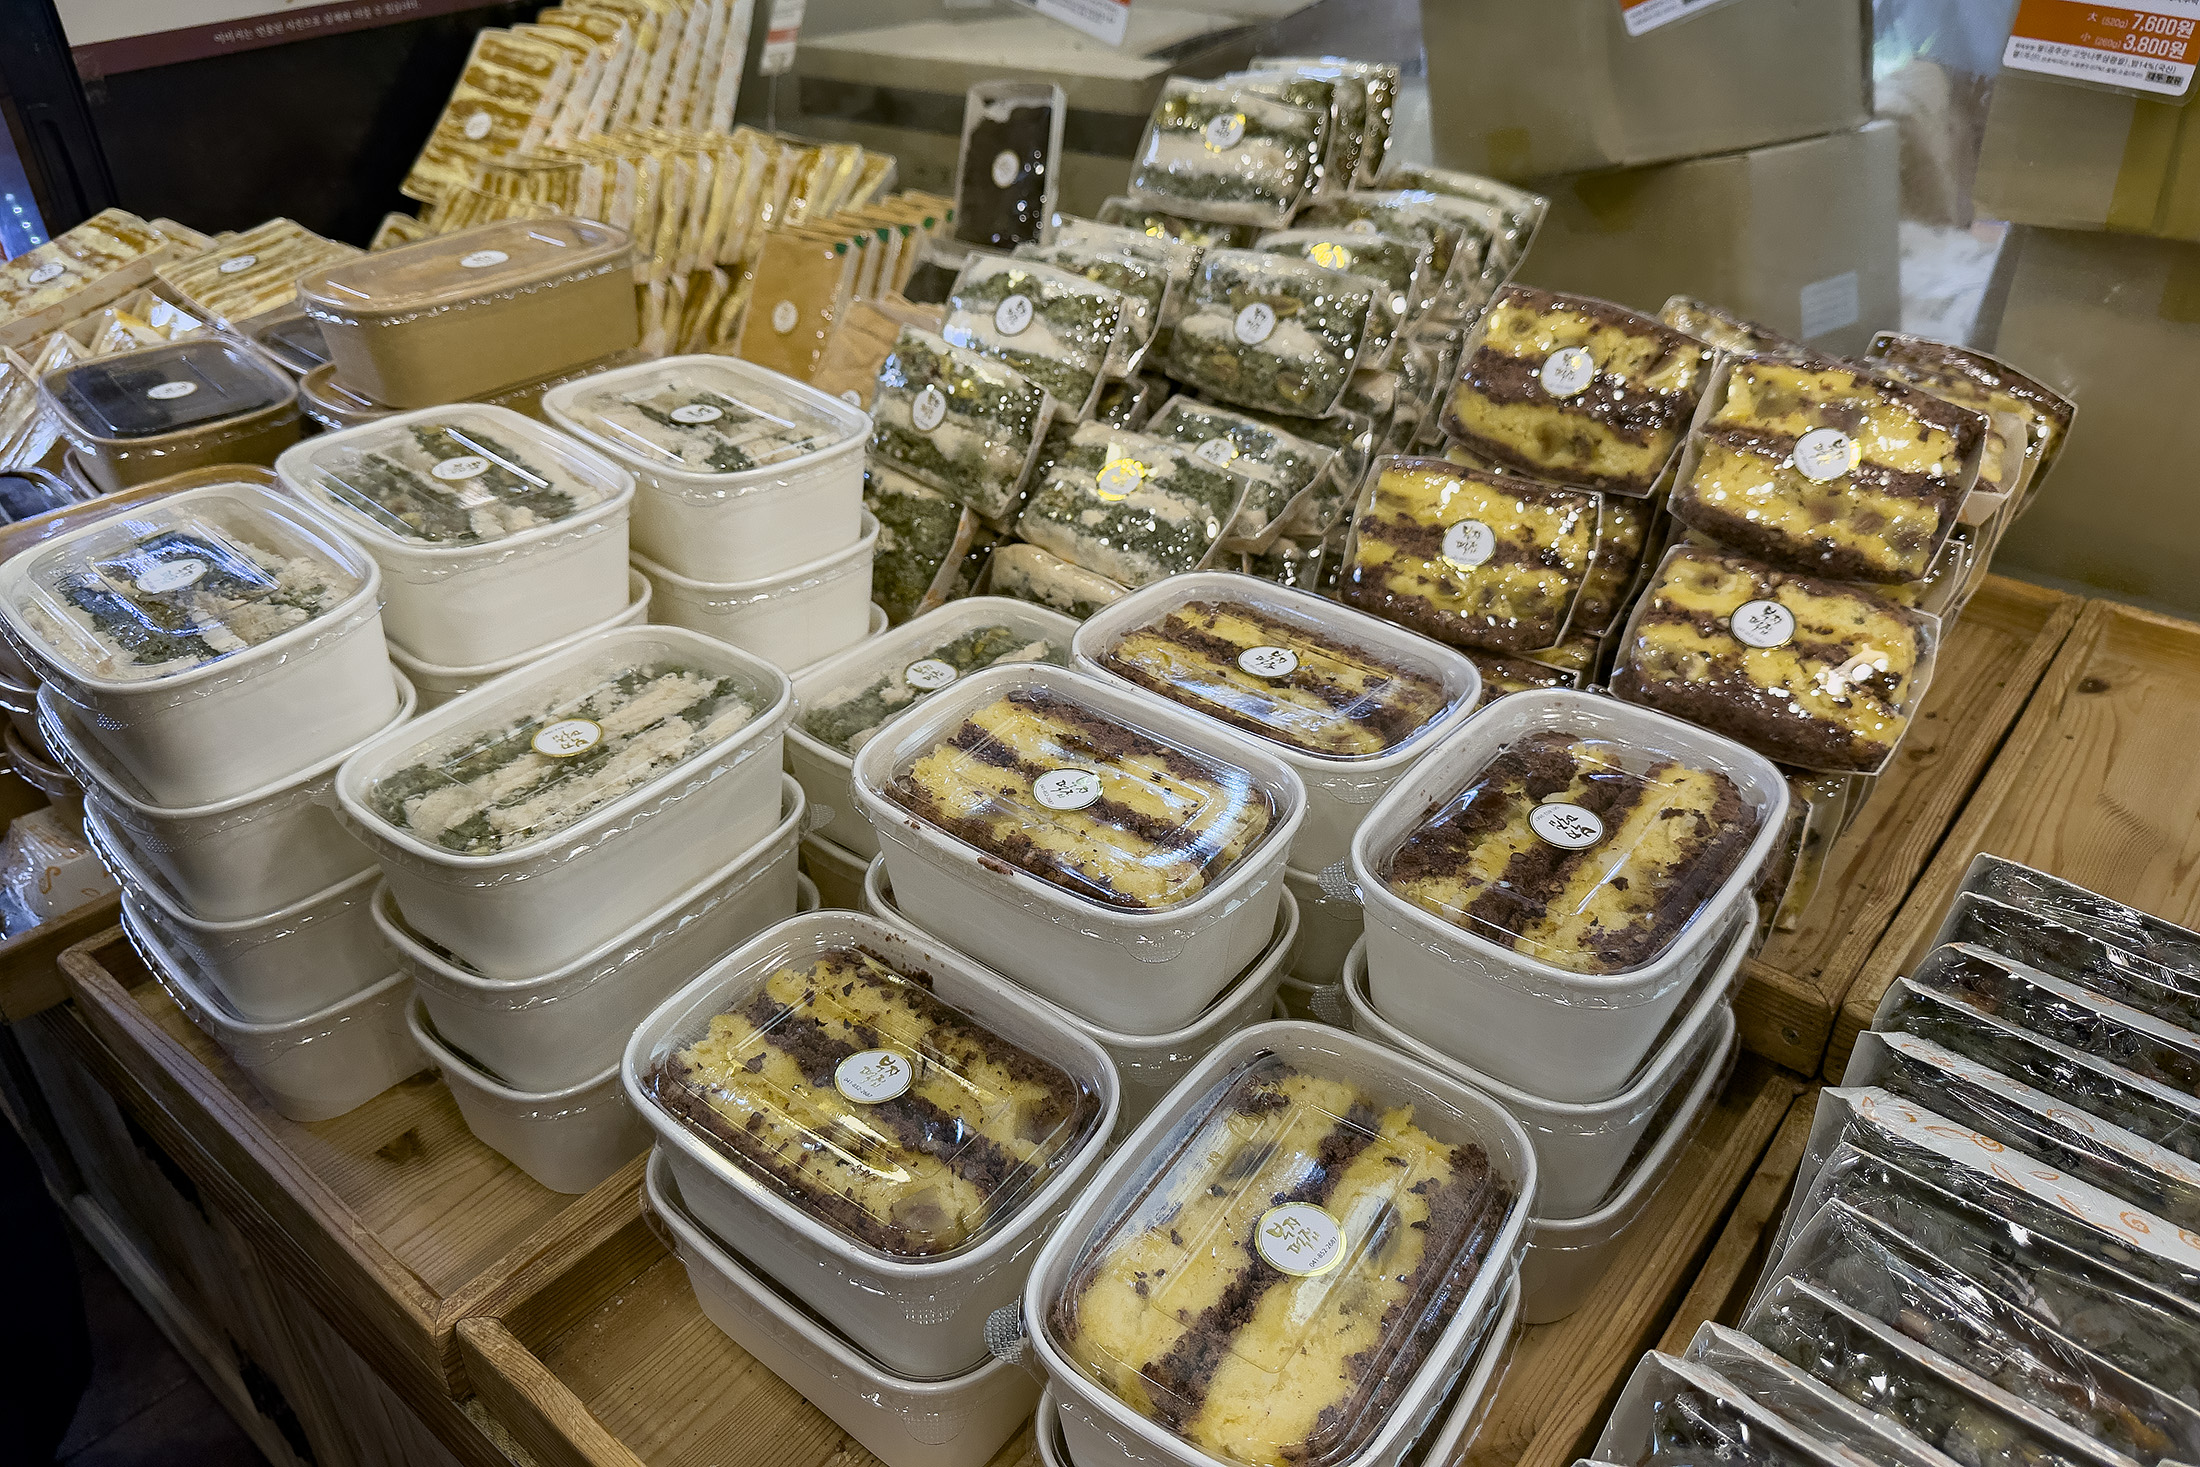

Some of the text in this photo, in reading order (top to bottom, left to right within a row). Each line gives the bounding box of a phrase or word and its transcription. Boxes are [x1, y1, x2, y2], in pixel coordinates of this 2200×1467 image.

[2131, 13, 2196, 39] 7,600원
[2123, 33, 2188, 60] 3,800원
[1309, 1236, 1337, 1268] 041-852-2687
